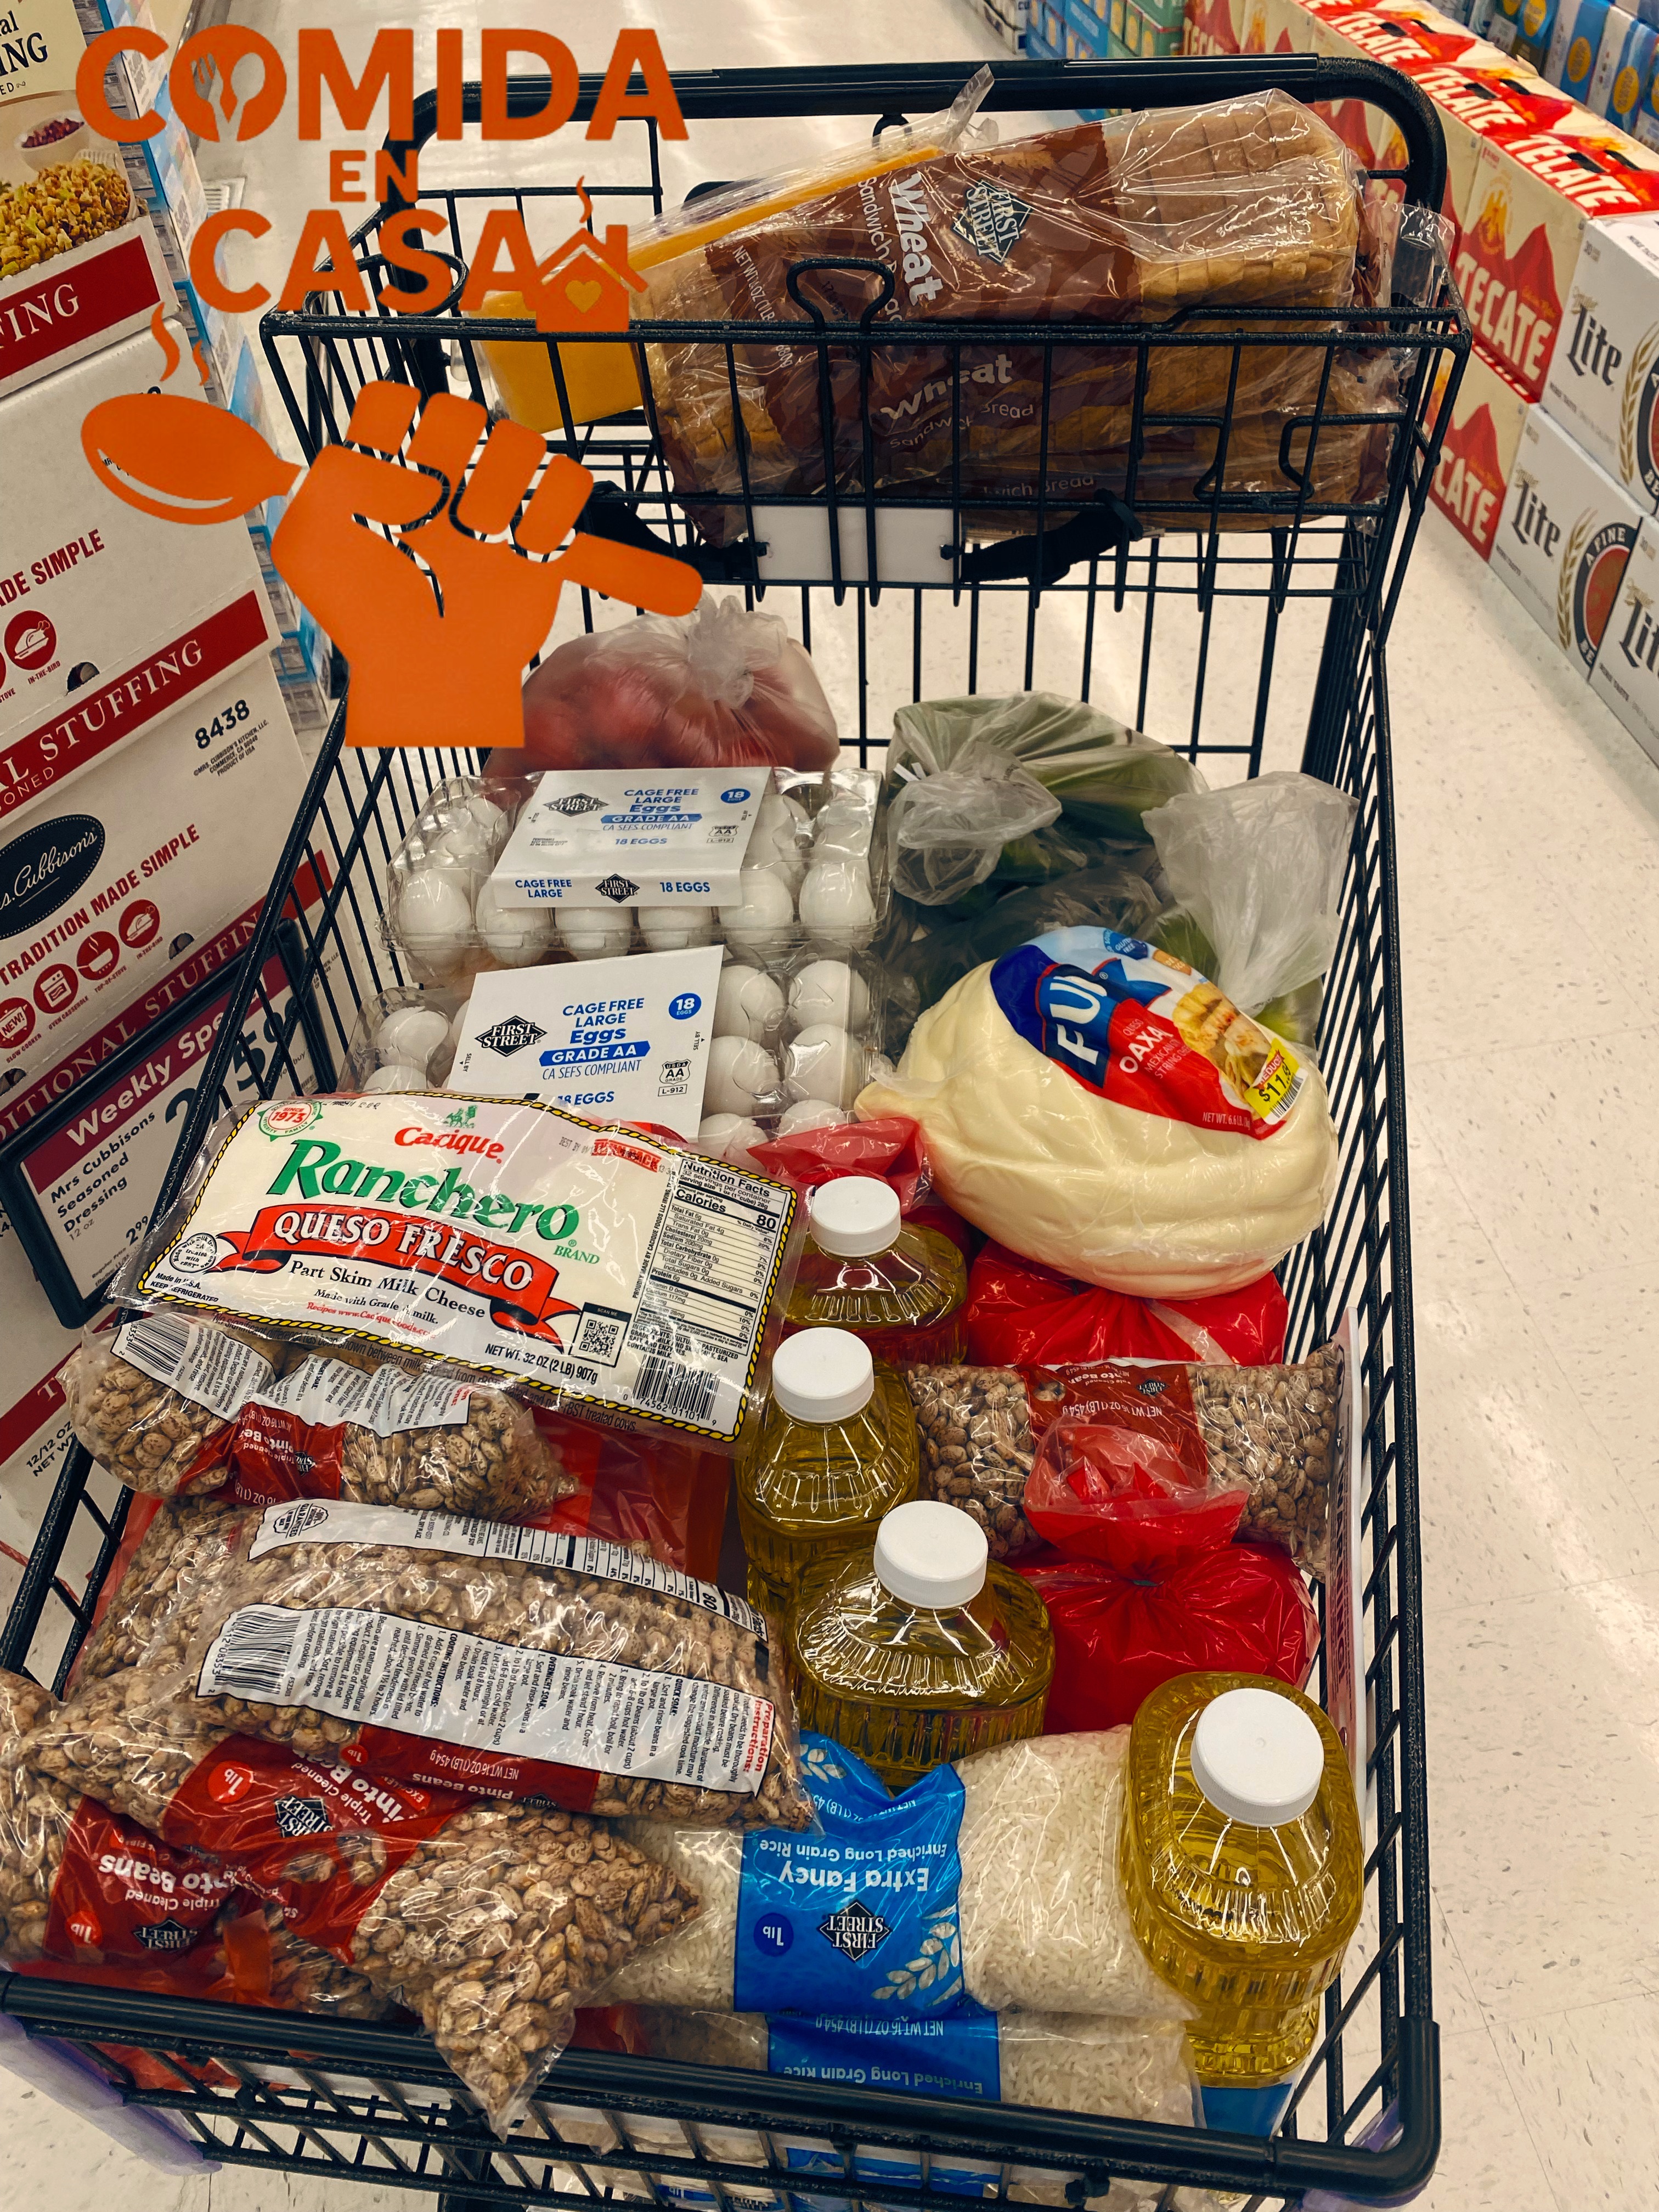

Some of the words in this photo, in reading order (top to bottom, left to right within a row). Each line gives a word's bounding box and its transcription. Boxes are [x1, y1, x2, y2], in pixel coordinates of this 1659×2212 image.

[1415, 67, 1527, 136] TECATE
[1505, 134, 1642, 210] TECATE
[858, 176, 893, 263] Sandwich
[889, 173, 944, 306] Wheat
[732, 245, 752, 267] NET
[1455, 252, 1553, 375] TECATE
[1566, 303, 1622, 386] Lite
[1511, 479, 1560, 557] Lite
[31, 529, 105, 585] SIMPLE
[27, 661, 61, 685] IN-THE-BIRD
[39, 639, 204, 762] STUFFING
[195, 699, 249, 749] 8438
[629, 804, 681, 814] Eggs
[14, 831, 98, 896] Cubbison's
[515, 879, 545, 888] CAGE
[601, 887, 635, 895] STREET
[605, 880, 630, 888] FIRST
[659, 882, 674, 892] 18
[676, 882, 711, 893] EGGS
[528, 889, 563, 898] LARGE
[0, 907, 90, 986] TRADITION
[90, 870, 140, 917] MADE
[140, 823, 200, 878] SIMPLE
[563, 1002, 606, 1016] CAGE
[609, 997, 645, 1012] FREE
[675, 997, 695, 1011] 18
[1, 1012, 25, 1036] NEW!
[492, 1023, 534, 1036] FIRST
[575, 1013, 627, 1028] LARGE
[1122, 1018, 1144, 1036] QUESO
[482, 1033, 538, 1048] STREET
[570, 1028, 627, 1045] Eggs
[551, 1047, 608, 1063] GRADE
[612, 1044, 637, 1058] AA
[543, 1068, 555, 1080] CA
[558, 1066, 583, 1079] SEFS
[584, 1059, 642, 1076] COMPLIANT
[665, 1068, 685, 1077] AA
[574, 1091, 615, 1105] EGGS
[662, 1086, 684, 1094] L-912
[66, 1055, 171, 1147] Weekly
[271, 1111, 306, 1123] 1973
[1203, 1112, 1215, 1122] NET
[50, 1176, 80, 1203] Mrs
[82, 1112, 155, 1175] Cubbisons
[57, 1152, 129, 1218] Seasoned
[680, 1175, 703, 1186] Serving
[684, 1161, 735, 1185] Nutrition
[738, 1180, 770, 1197] Facts
[693, 1173, 723, 1186] servings
[266, 1139, 580, 1241] Ranchero
[64, 1177, 128, 1233] Dressing
[672, 1205, 685, 1214] Total
[676, 1189, 726, 1212] Calories
[757, 1214, 776, 1229] 80
[662, 1233, 684, 1243] Sodium
[665, 1226, 696, 1240] Cholesterol
[697, 1236, 713, 1245] 20mg
[274, 1210, 390, 1245] QUESO
[400, 1222, 534, 1291] FRESCO
[553, 1245, 600, 1265] BRAND
[675, 1243, 711, 1260] Carbohydrate
[155, 1273, 174, 1282] Made
[652, 1268, 672, 1279] Protein
[289, 1260, 325, 1280] Part
[329, 1267, 373, 1289] Skim
[377, 1277, 420, 1296] Milk
[425, 1286, 486, 1318] Cheese
[485, 1343, 505, 1357] NET
[523, 1353, 534, 1364] 32
[535, 1355, 549, 1368] OZ
[560, 1363, 575, 1379] LB)
[576, 1366, 598, 1385] 907g
[1110, 1401, 1121, 1410] OZ
[1146, 1406, 1163, 1418] NET
[586, 1408, 613, 1425] treated
[614, 1417, 636, 1432] cows.
[444, 1633, 458, 1663] COOKING
[754, 1703, 773, 1772] Preparation
[291, 1762, 340, 1796] Cleaned
[503, 1768, 519, 1780] NET
[340, 1793, 372, 1825] Triple
[759, 1839, 792, 1858] Rice
[796, 1844, 840, 1863] Grain
[844, 1849, 882, 1863] Long
[888, 1843, 947, 1862] Enriched
[98, 1854, 177, 1893] Beans
[778, 1860, 857, 1892] Fancy
[865, 1867, 929, 1893] Extra
[125, 1888, 179, 1911] Cleaned
[70, 1922, 93, 1944] 1lb
[827, 1915, 884, 1933] STREET
[763, 1925, 784, 1947] 1lb
[832, 1932, 877, 1949] FIRST
[821, 2067, 867, 2084] Grain
[871, 2066, 911, 2085] Long
